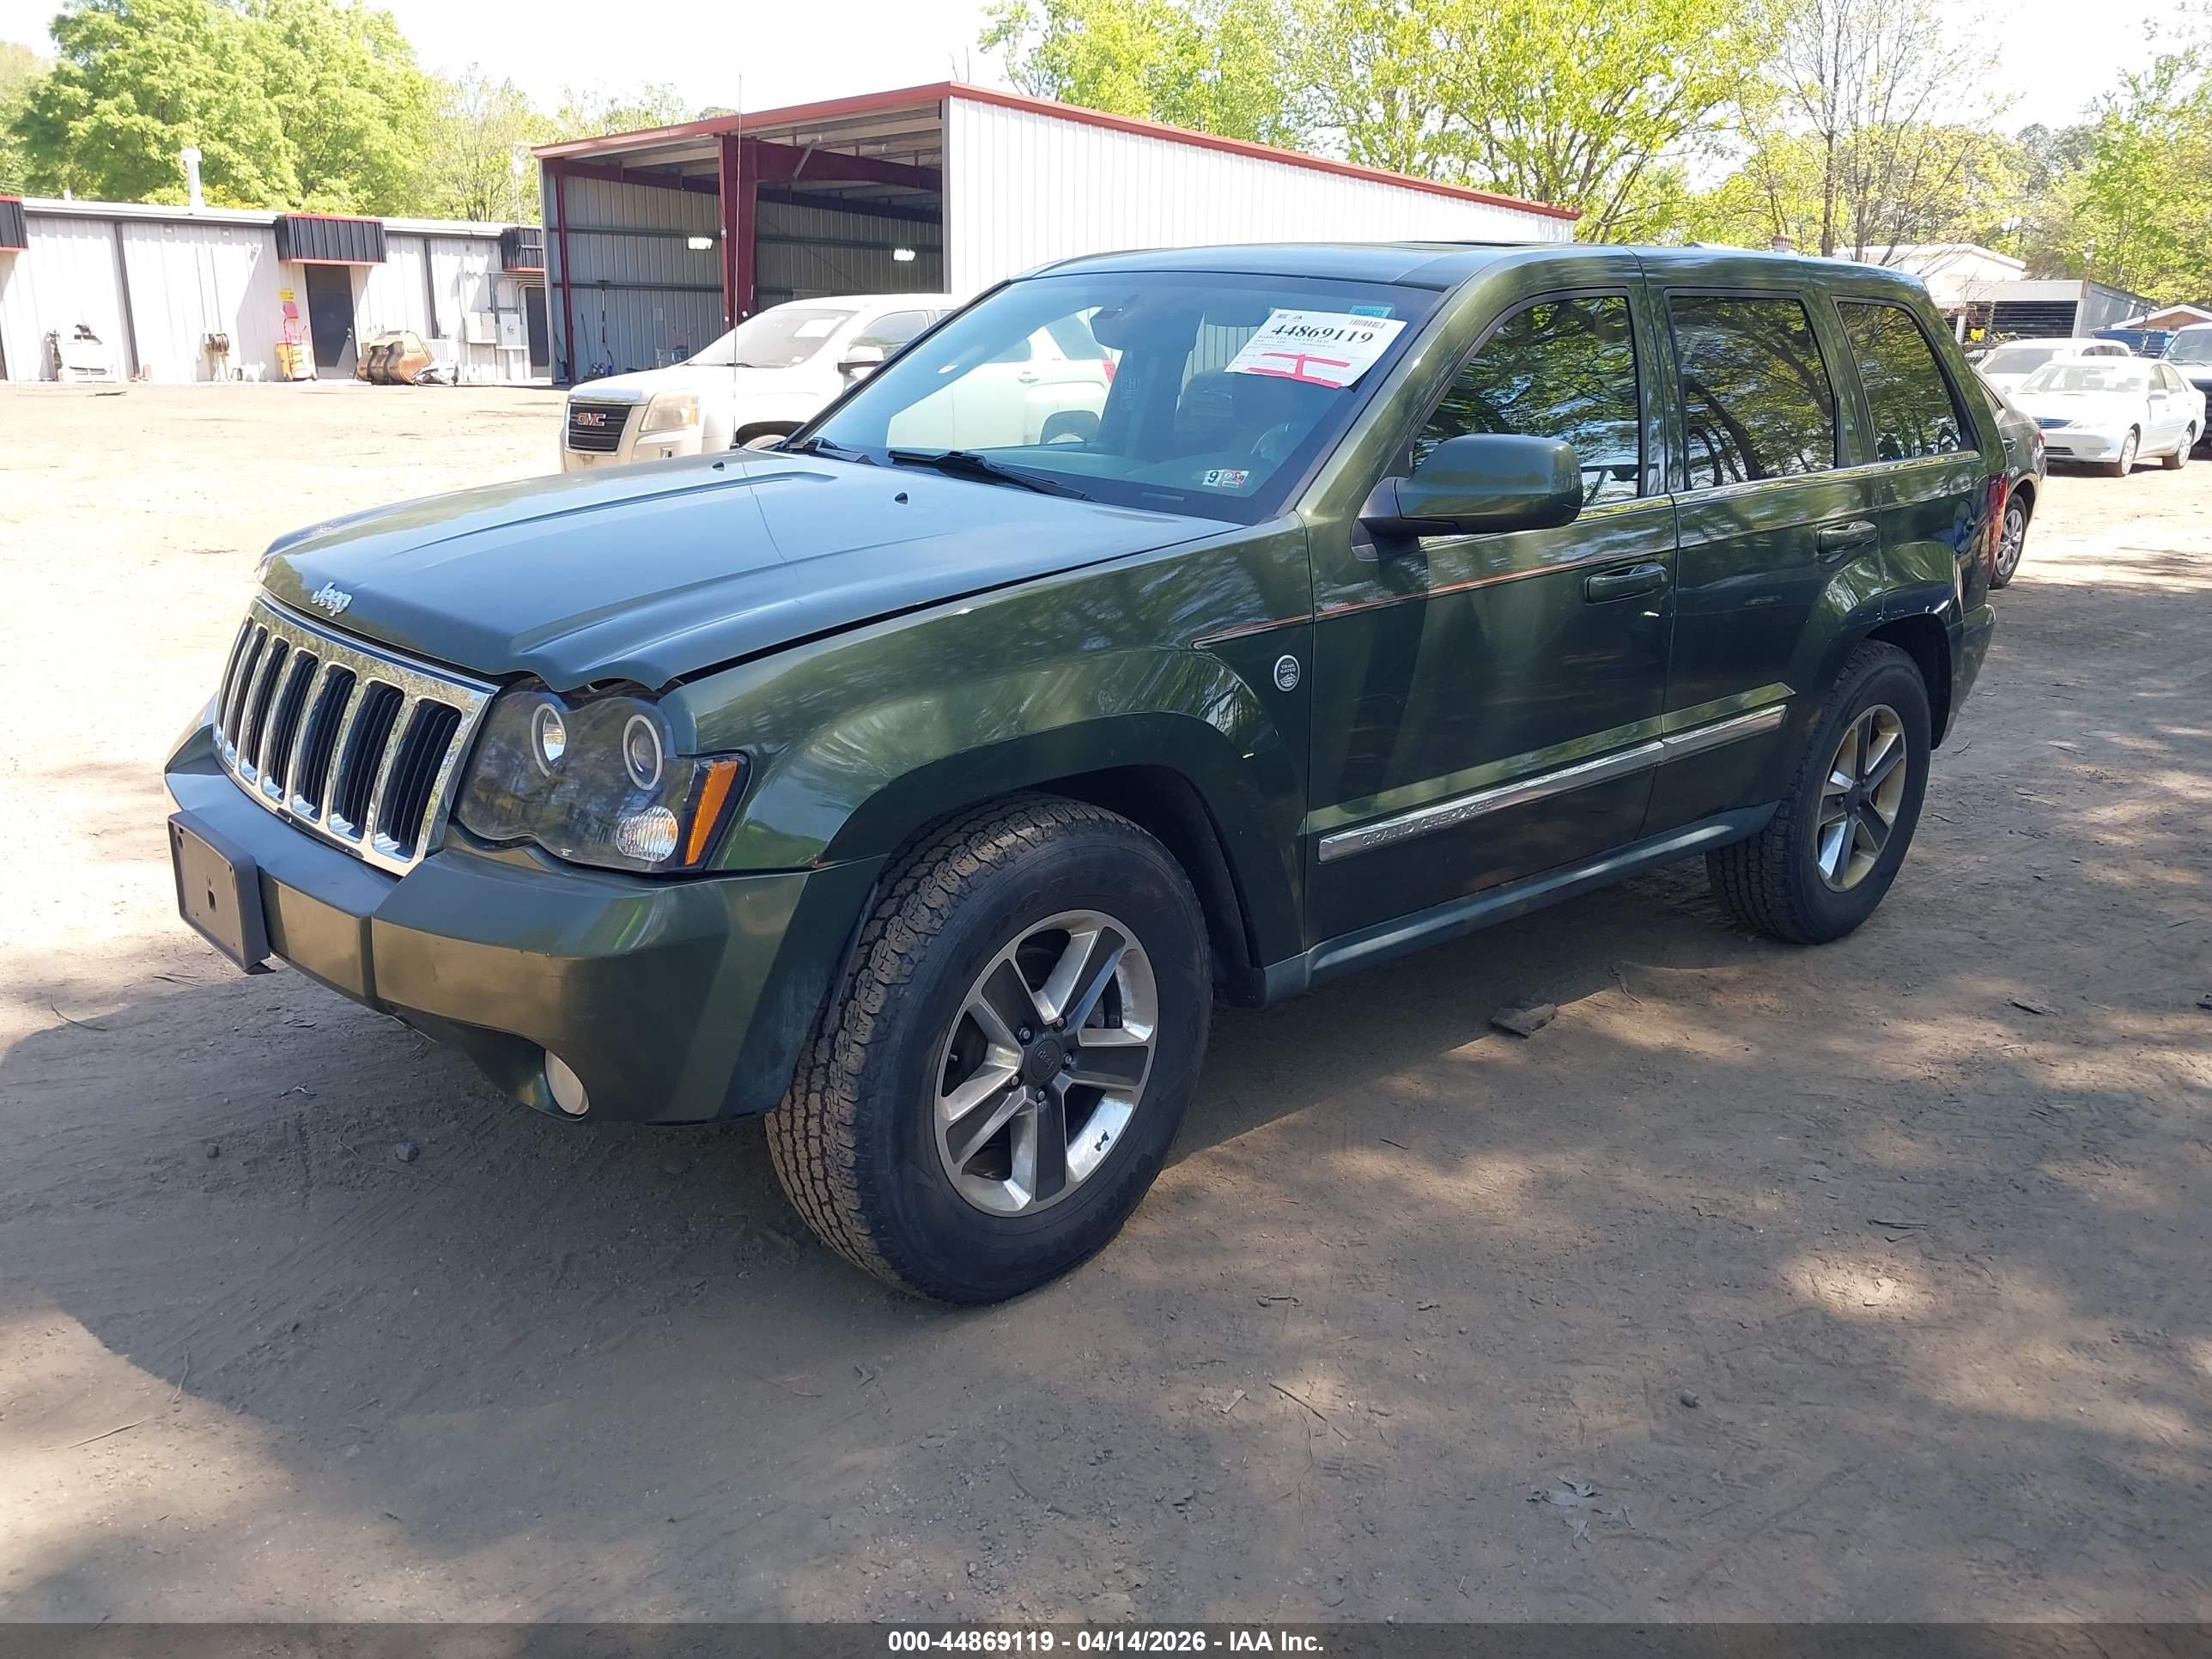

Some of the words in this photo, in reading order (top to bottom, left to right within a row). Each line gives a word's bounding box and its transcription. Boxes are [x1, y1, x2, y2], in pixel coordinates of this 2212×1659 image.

[1272, 324, 1374, 343] 44869119
[577, 412, 606, 427] GMC
[1207, 471, 1219, 483] 9
[310, 581, 352, 617] Jeep
[1361, 823, 1415, 846] GRAND
[1421, 799, 1493, 830] CHEROKEE
